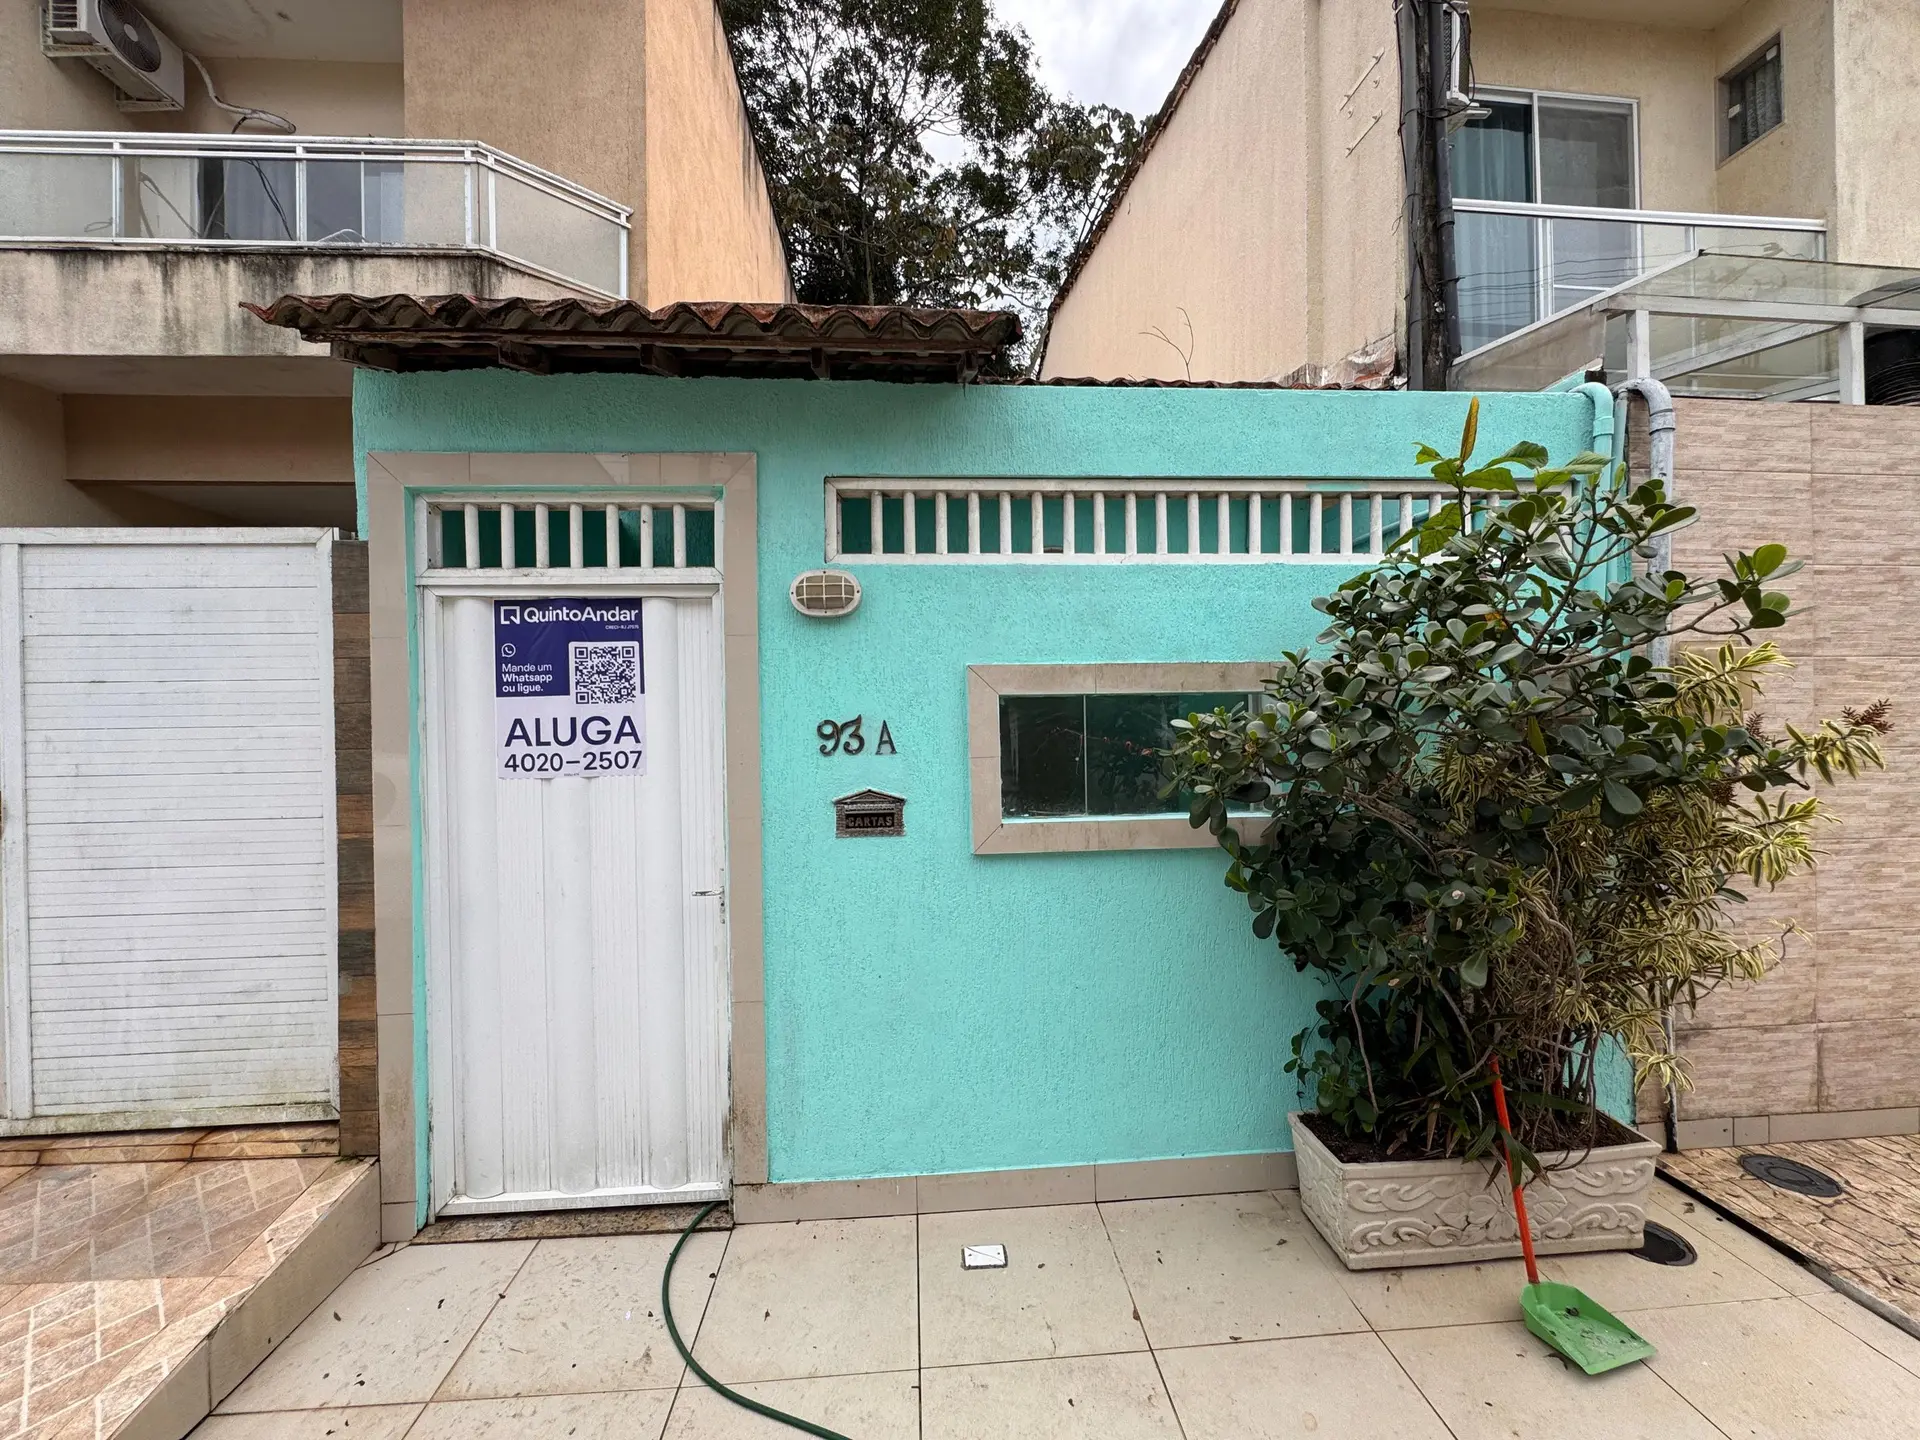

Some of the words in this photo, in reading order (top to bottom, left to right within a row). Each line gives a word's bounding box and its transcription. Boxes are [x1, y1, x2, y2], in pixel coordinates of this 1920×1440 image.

[523, 606, 639, 623] QuintoAndar
[501, 663, 536, 672] Mande
[501, 673, 553, 683] Whatsapp
[517, 683, 544, 694] ligue.
[504, 715, 641, 747] ALUGA
[816, 714, 865, 756] 93
[875, 719, 898, 755] A
[504, 750, 643, 773] 4020-2507
[848, 816, 893, 827] CARTAS
